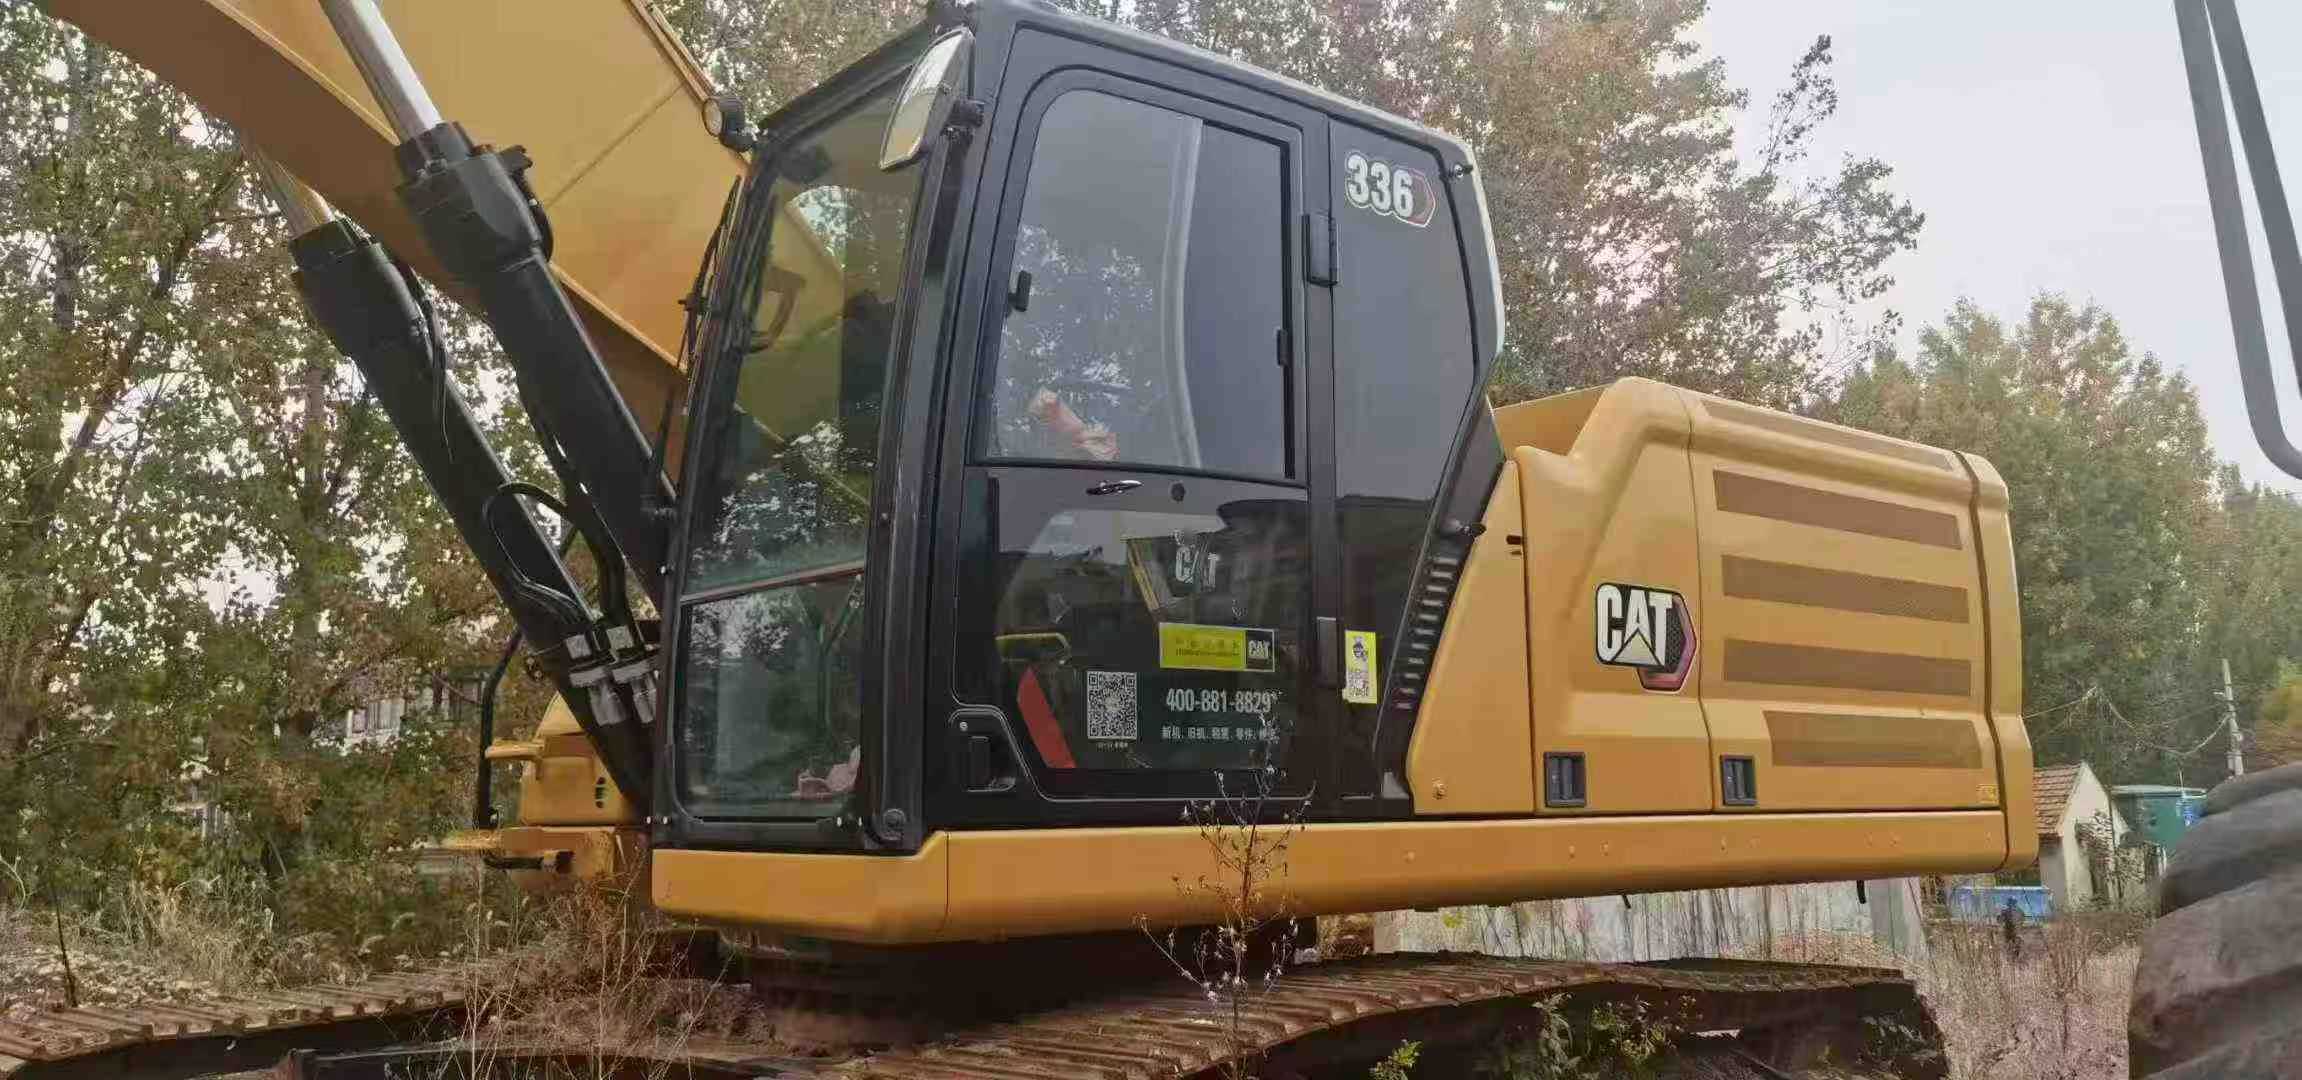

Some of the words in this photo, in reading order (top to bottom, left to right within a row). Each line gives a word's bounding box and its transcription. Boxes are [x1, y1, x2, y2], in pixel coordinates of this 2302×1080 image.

[1346, 153, 1414, 218] 336
[1248, 639, 1271, 659] CAT
[1597, 584, 1673, 667] CAT
